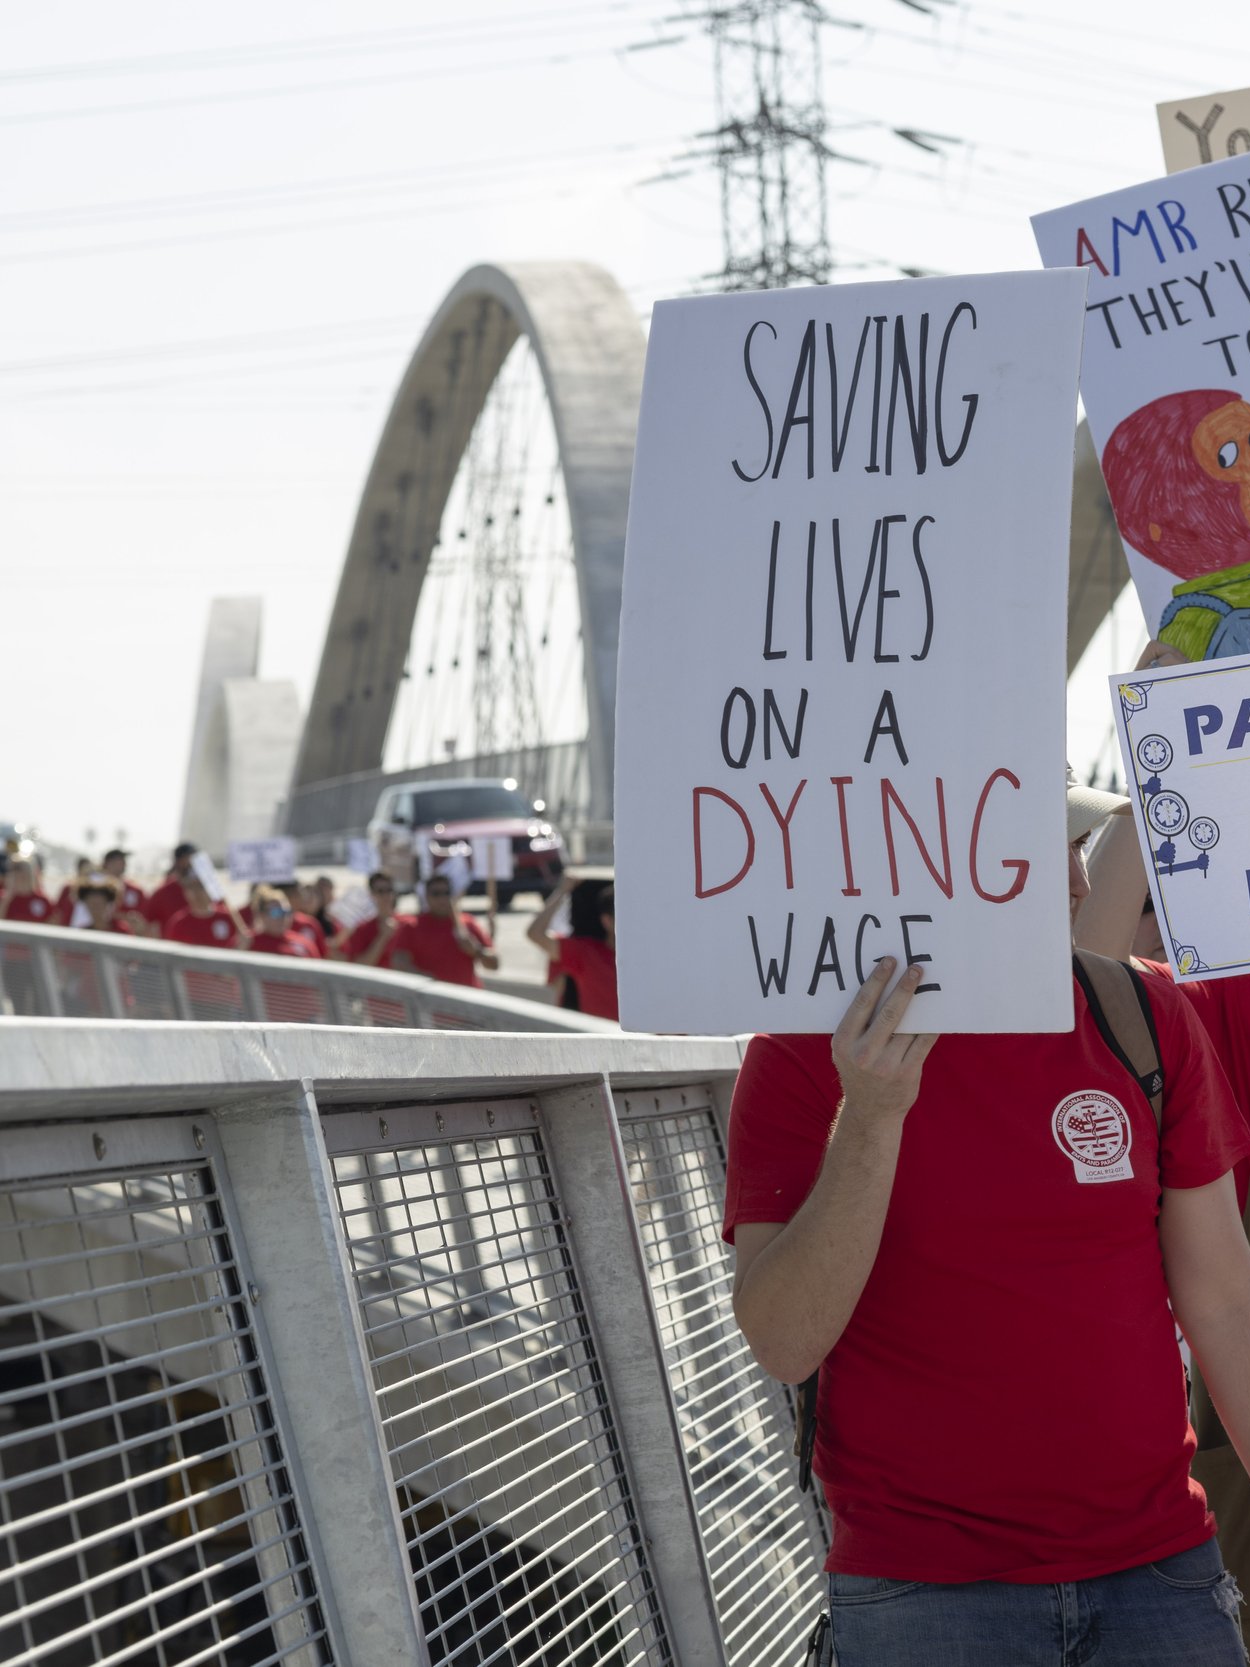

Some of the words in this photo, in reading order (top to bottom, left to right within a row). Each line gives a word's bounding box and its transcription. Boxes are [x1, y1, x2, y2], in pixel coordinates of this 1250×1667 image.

[1074, 199, 1199, 279] AMR
[731, 301, 980, 483] SAVING
[762, 514, 938, 664] LIVES
[720, 686, 809, 770] ON
[863, 689, 910, 766] A
[691, 767, 1031, 904] DYING
[747, 911, 942, 999] WAGE
